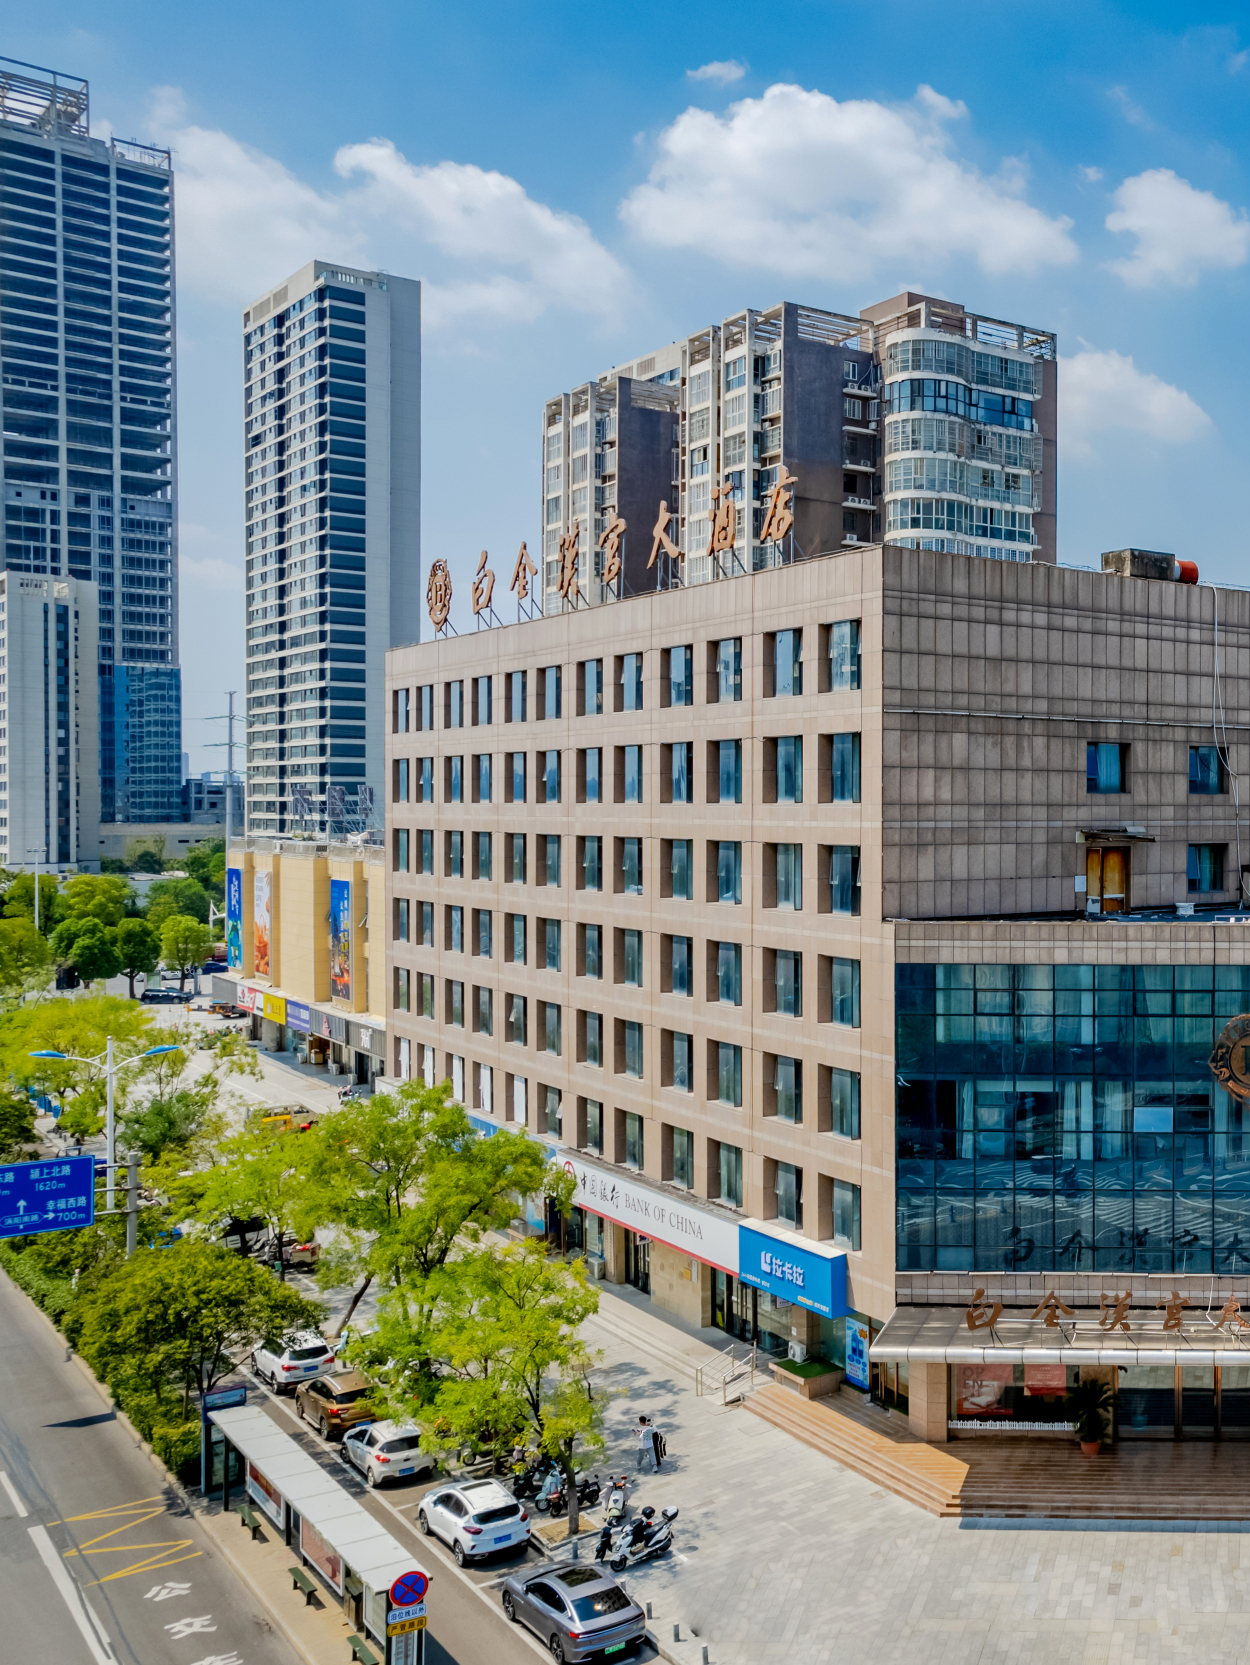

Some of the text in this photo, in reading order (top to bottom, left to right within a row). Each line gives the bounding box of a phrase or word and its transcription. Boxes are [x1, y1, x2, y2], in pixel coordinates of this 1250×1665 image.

[46, 1196, 87, 1211] 幸福西路
[624, 1193, 650, 1218] BANK
[653, 1205, 666, 1224] OF
[669, 1211, 704, 1240] CHINA
[772, 1256, 804, 1287] 拉卡拉
